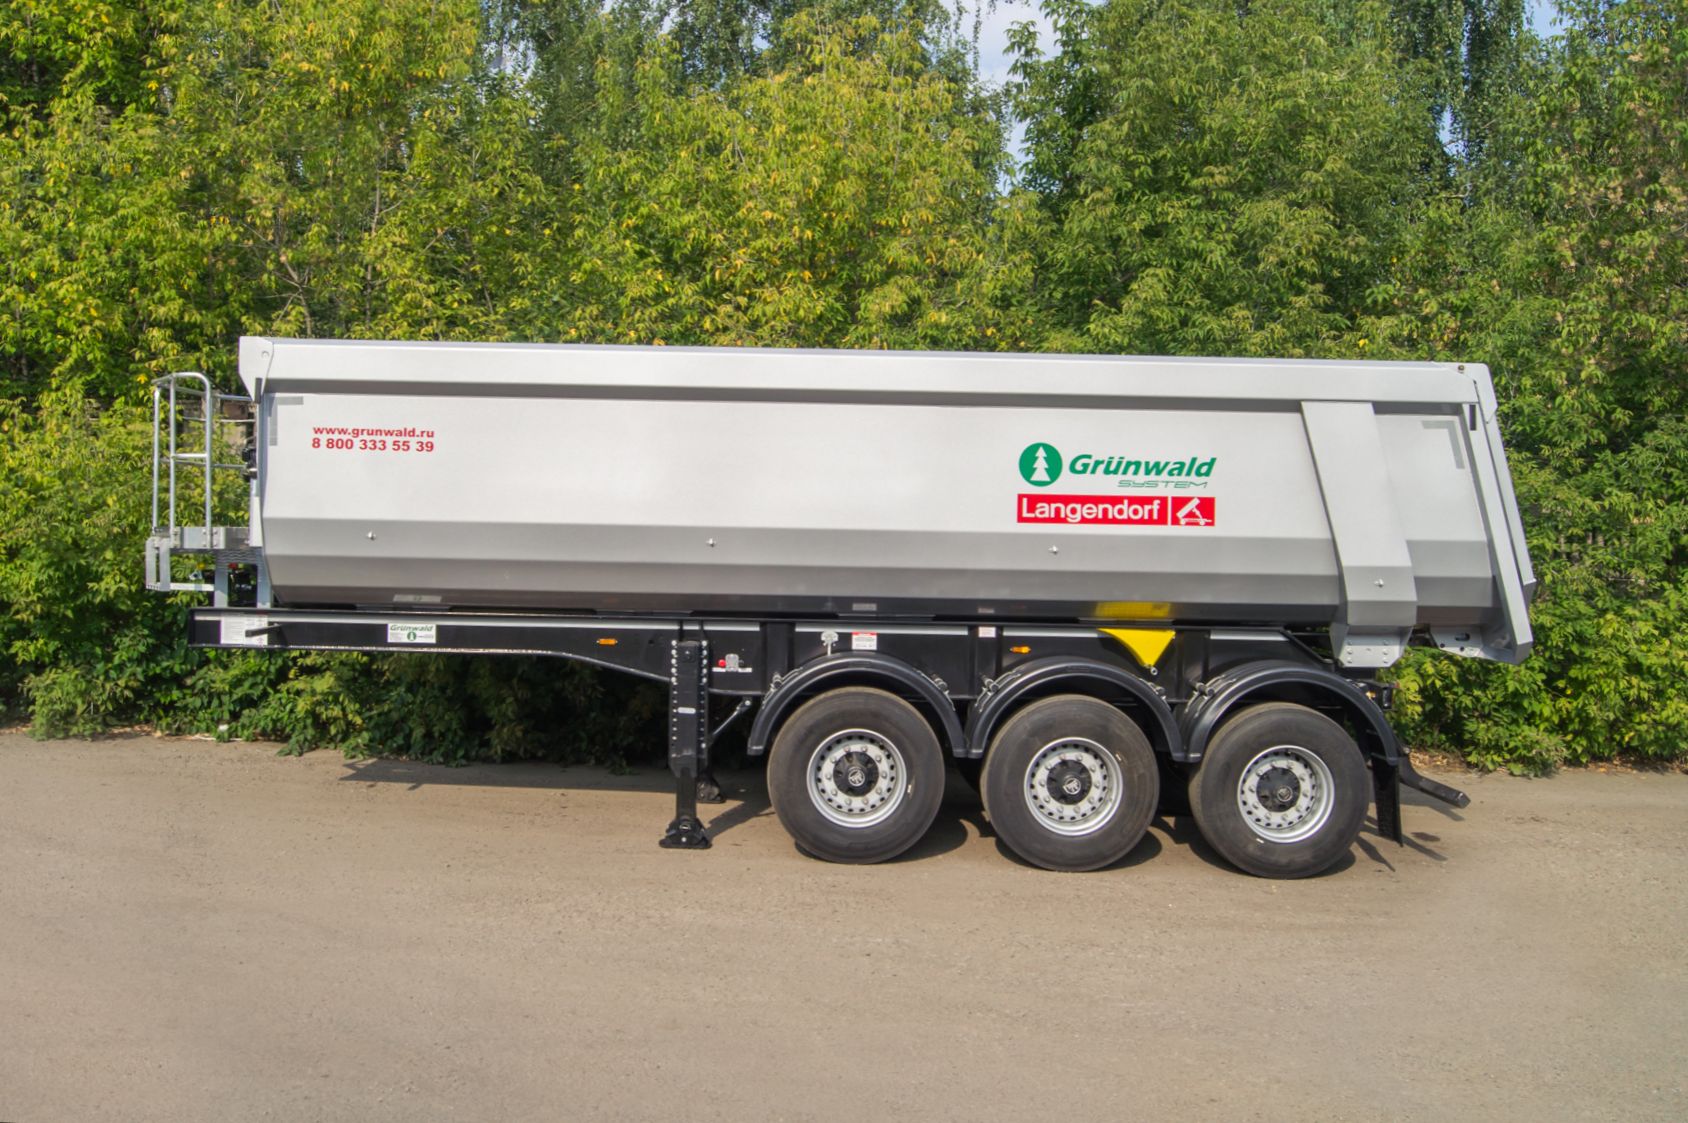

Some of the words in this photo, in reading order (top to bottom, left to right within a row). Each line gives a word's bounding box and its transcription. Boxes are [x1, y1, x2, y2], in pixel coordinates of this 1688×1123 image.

[313, 427, 435, 438] www.grunwald.ru
[312, 438, 321, 449] 8
[326, 438, 354, 450] 800
[359, 439, 387, 451] 333
[392, 440, 411, 452] 55
[416, 441, 435, 452] 39
[1068, 454, 1217, 477] Grünwald
[1022, 497, 1161, 523] Langendorf
